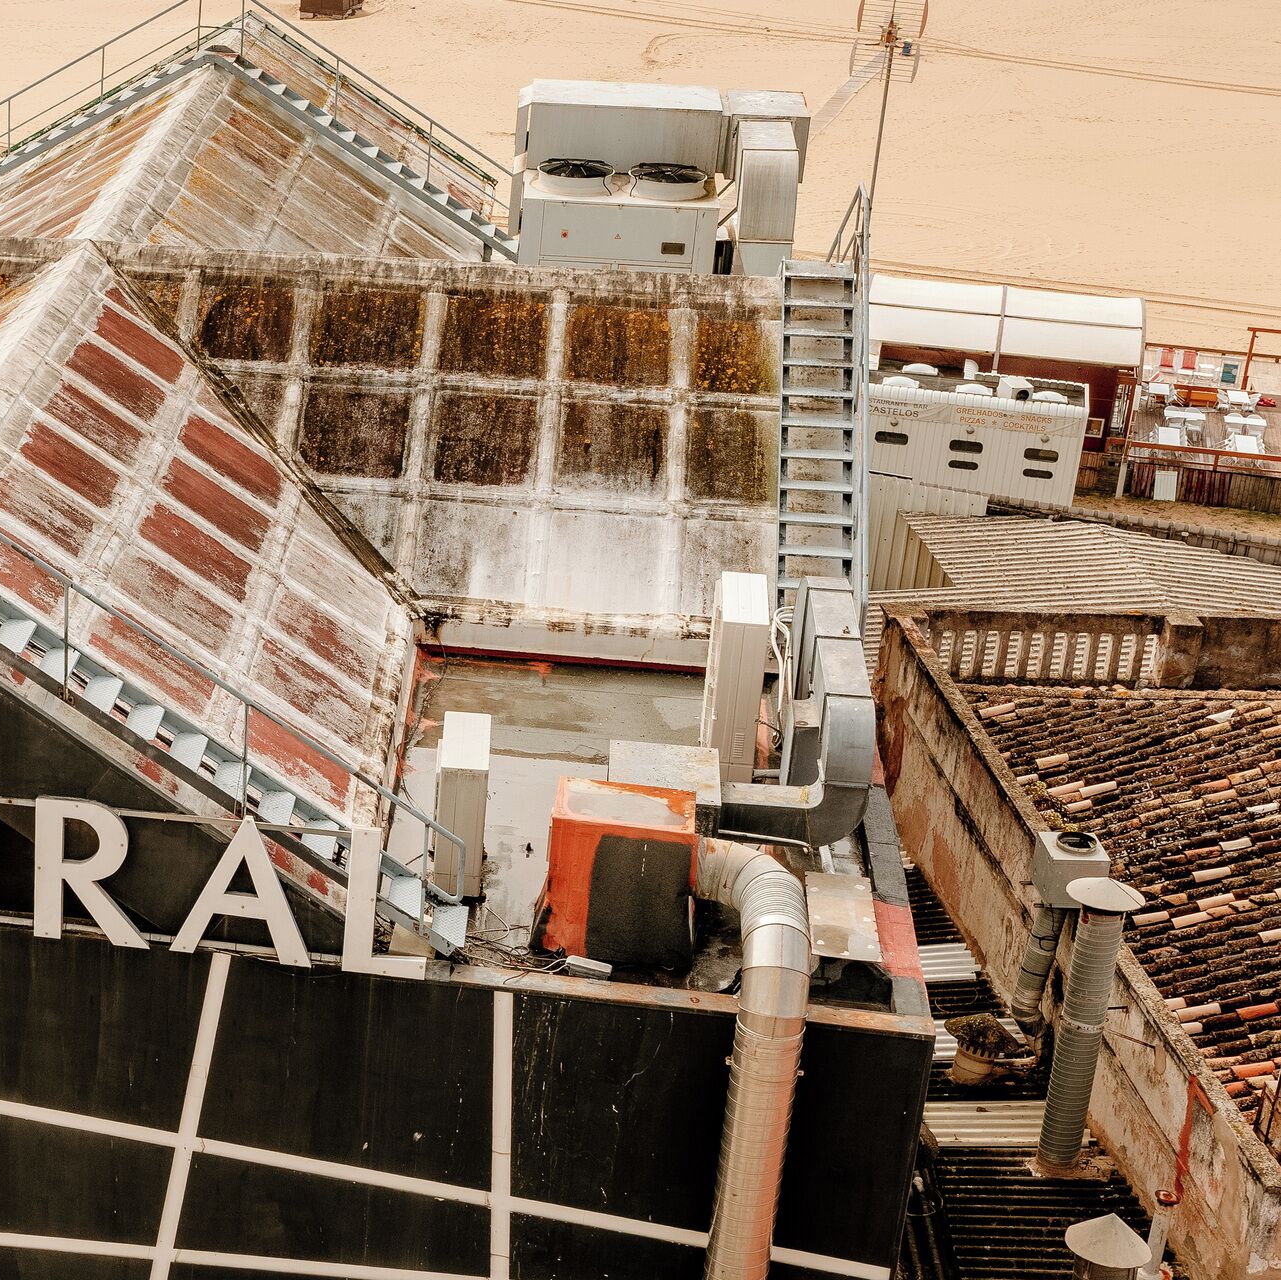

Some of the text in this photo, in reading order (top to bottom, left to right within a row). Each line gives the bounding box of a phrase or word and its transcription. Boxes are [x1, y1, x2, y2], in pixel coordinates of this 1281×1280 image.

[869, 398, 928, 411] STAURANTE BAR
[956, 407, 1053, 424] GRELHADOS SNACKS
[959, 416, 1046, 432] PIZZAS COCKTAILS
